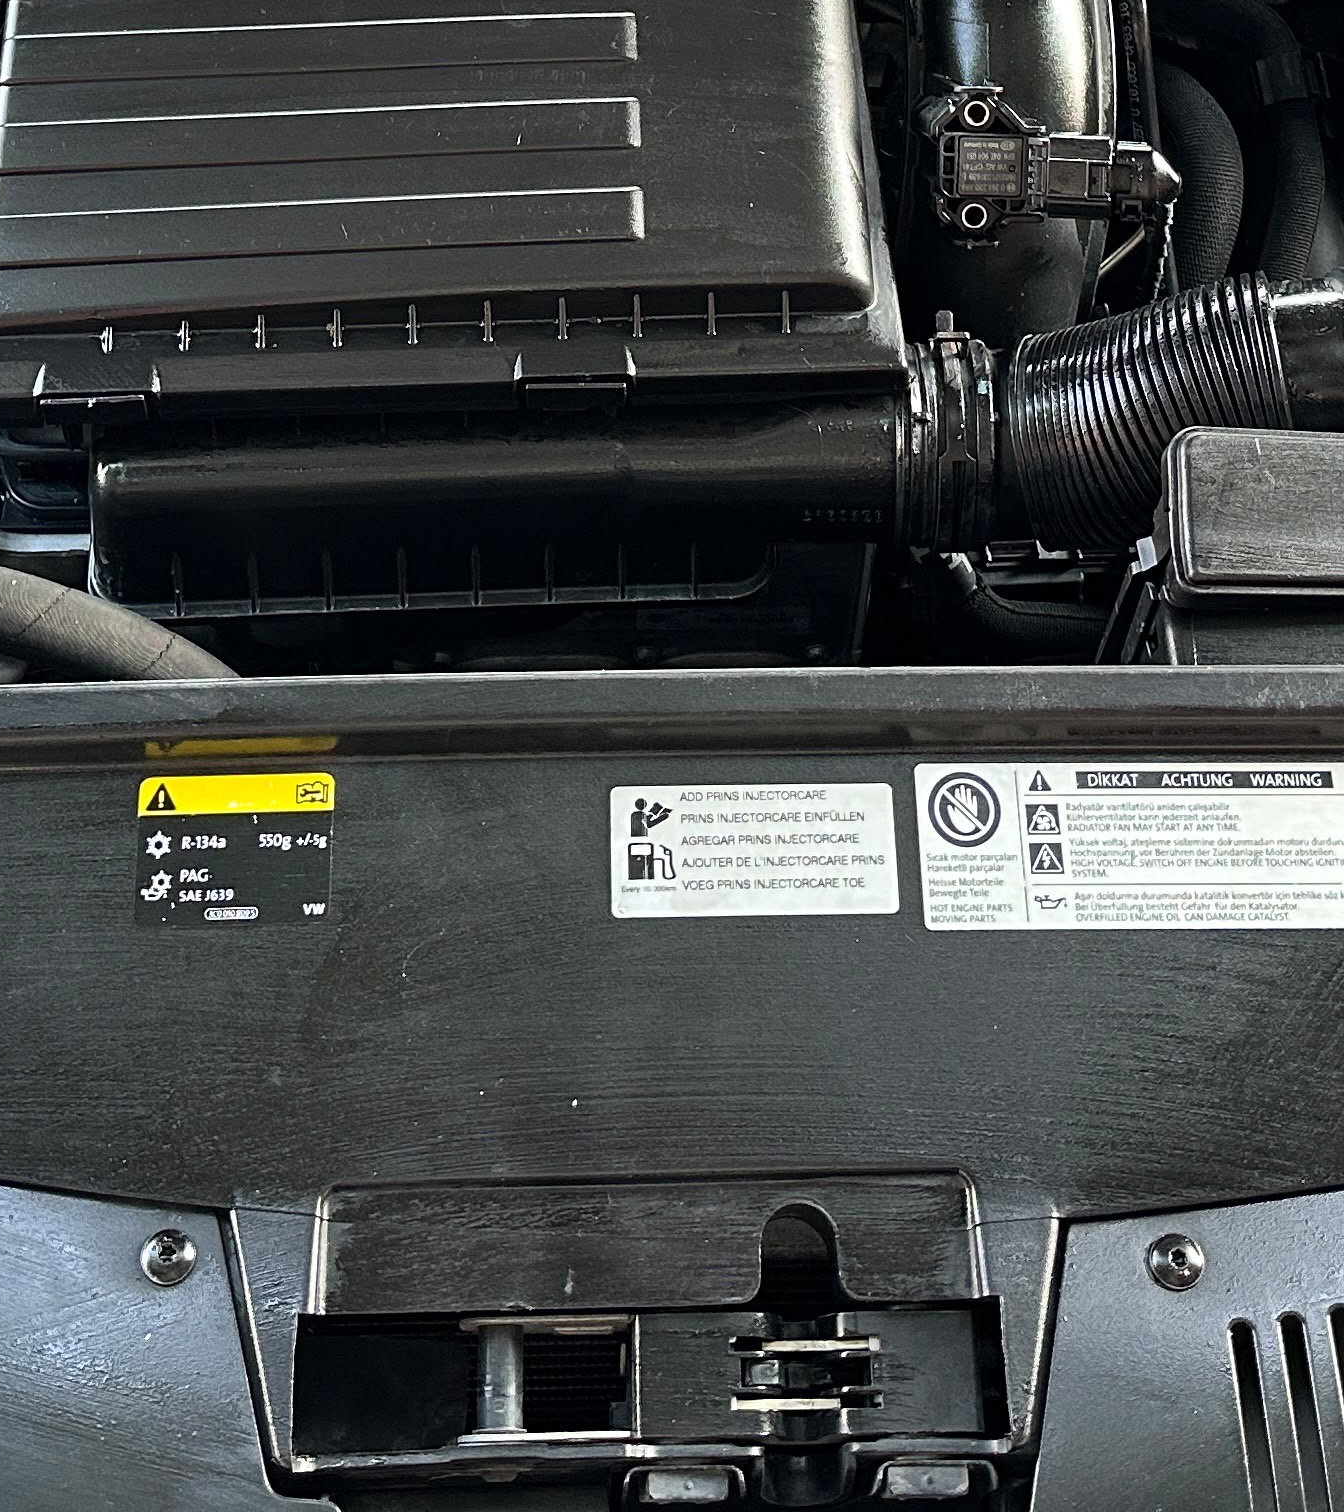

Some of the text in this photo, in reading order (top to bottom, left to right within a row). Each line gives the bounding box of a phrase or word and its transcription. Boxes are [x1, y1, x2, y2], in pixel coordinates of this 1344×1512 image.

[1087, 772, 1323, 787] DİKKAT ACHTUNG WARNING
[679, 790, 827, 802] ADD PRINS INJECTORCARE
[680, 810, 865, 824] PRINS INJECTORCARE EINFÜLLEN
[1067, 823, 1112, 832] RADIATOR
[1113, 823, 1131, 832] FAN
[1133, 823, 1153, 832] MAY
[1155, 823, 1181, 832] START
[1183, 823, 1194, 832] AT
[1195, 823, 1214, 832] ANY
[181, 833, 328, 851] R-134a 550g +/-5g
[681, 833, 861, 846] AGREGAR PRINS INJECTORCARE
[950, 853, 978, 862] motor
[1139, 849, 1153, 857] vor
[1196, 848, 1211, 857] der
[1265, 848, 1293, 857] Motor
[681, 855, 886, 868] AJOUTER DE L'INJECTORCARE PRINS
[1071, 859, 1095, 868] HIGH
[1139, 859, 1175, 868] SWITCH
[1176, 859, 1193, 868] OFF
[1195, 859, 1229, 868] ENGINE
[1230, 859, 1265, 868] BEFORE
[1265, 858, 1314, 867] TOUCHING
[179, 869, 210, 883] PAG
[681, 877, 866, 891] VOEG PRINS INJECTORCARE TOE
[178, 889, 235, 902] SAE J639
[969, 888, 990, 897] Teile
[302, 902, 326, 916] VW
[930, 904, 1014, 913] HOT ENGINE PARTS
[1075, 902, 1089, 911] Bei
[1230, 902, 1247, 911] den
[930, 914, 997, 923] MOVING PARTS
[1076, 913, 1128, 922] OVERFILLED
[1129, 913, 1164, 922] ENGINE
[1166, 913, 1181, 922] OIL
[1184, 913, 1204, 922] CAN
[1206, 913, 1246, 922] DAMAGE
